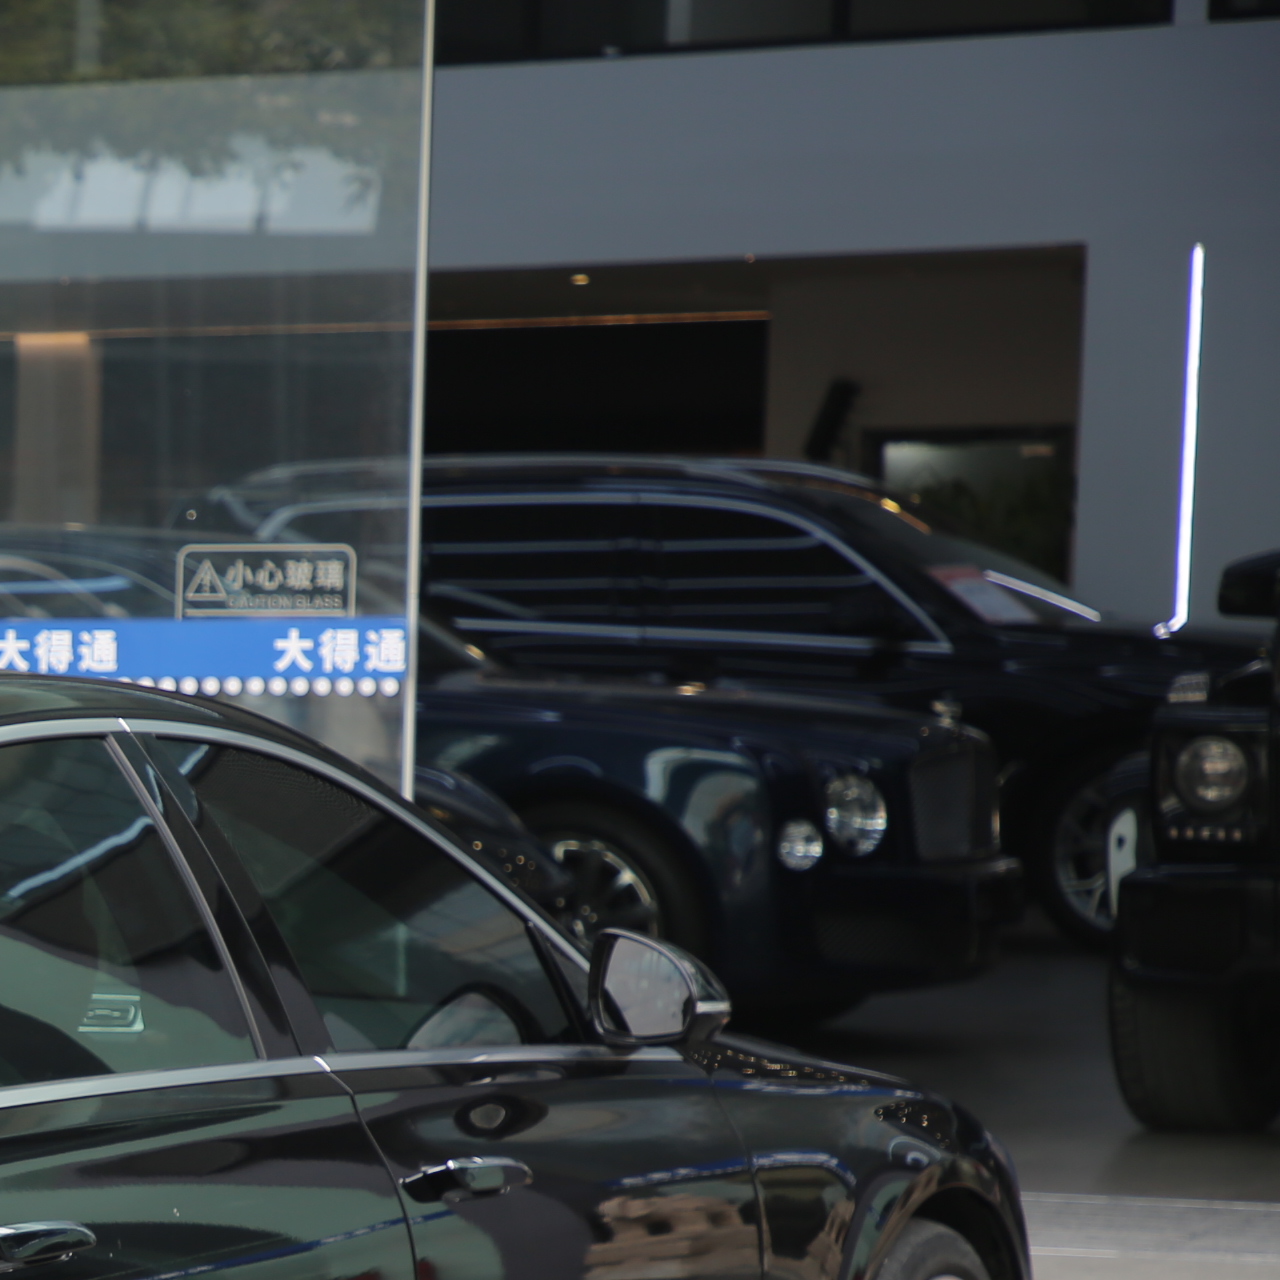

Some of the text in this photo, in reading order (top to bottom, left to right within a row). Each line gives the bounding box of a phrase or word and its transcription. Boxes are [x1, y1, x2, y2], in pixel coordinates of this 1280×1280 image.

[225, 558, 344, 591] 小心玻璃
[226, 595, 343, 609] CAUTION GLASS
[273, 627, 406, 673] 大得通
